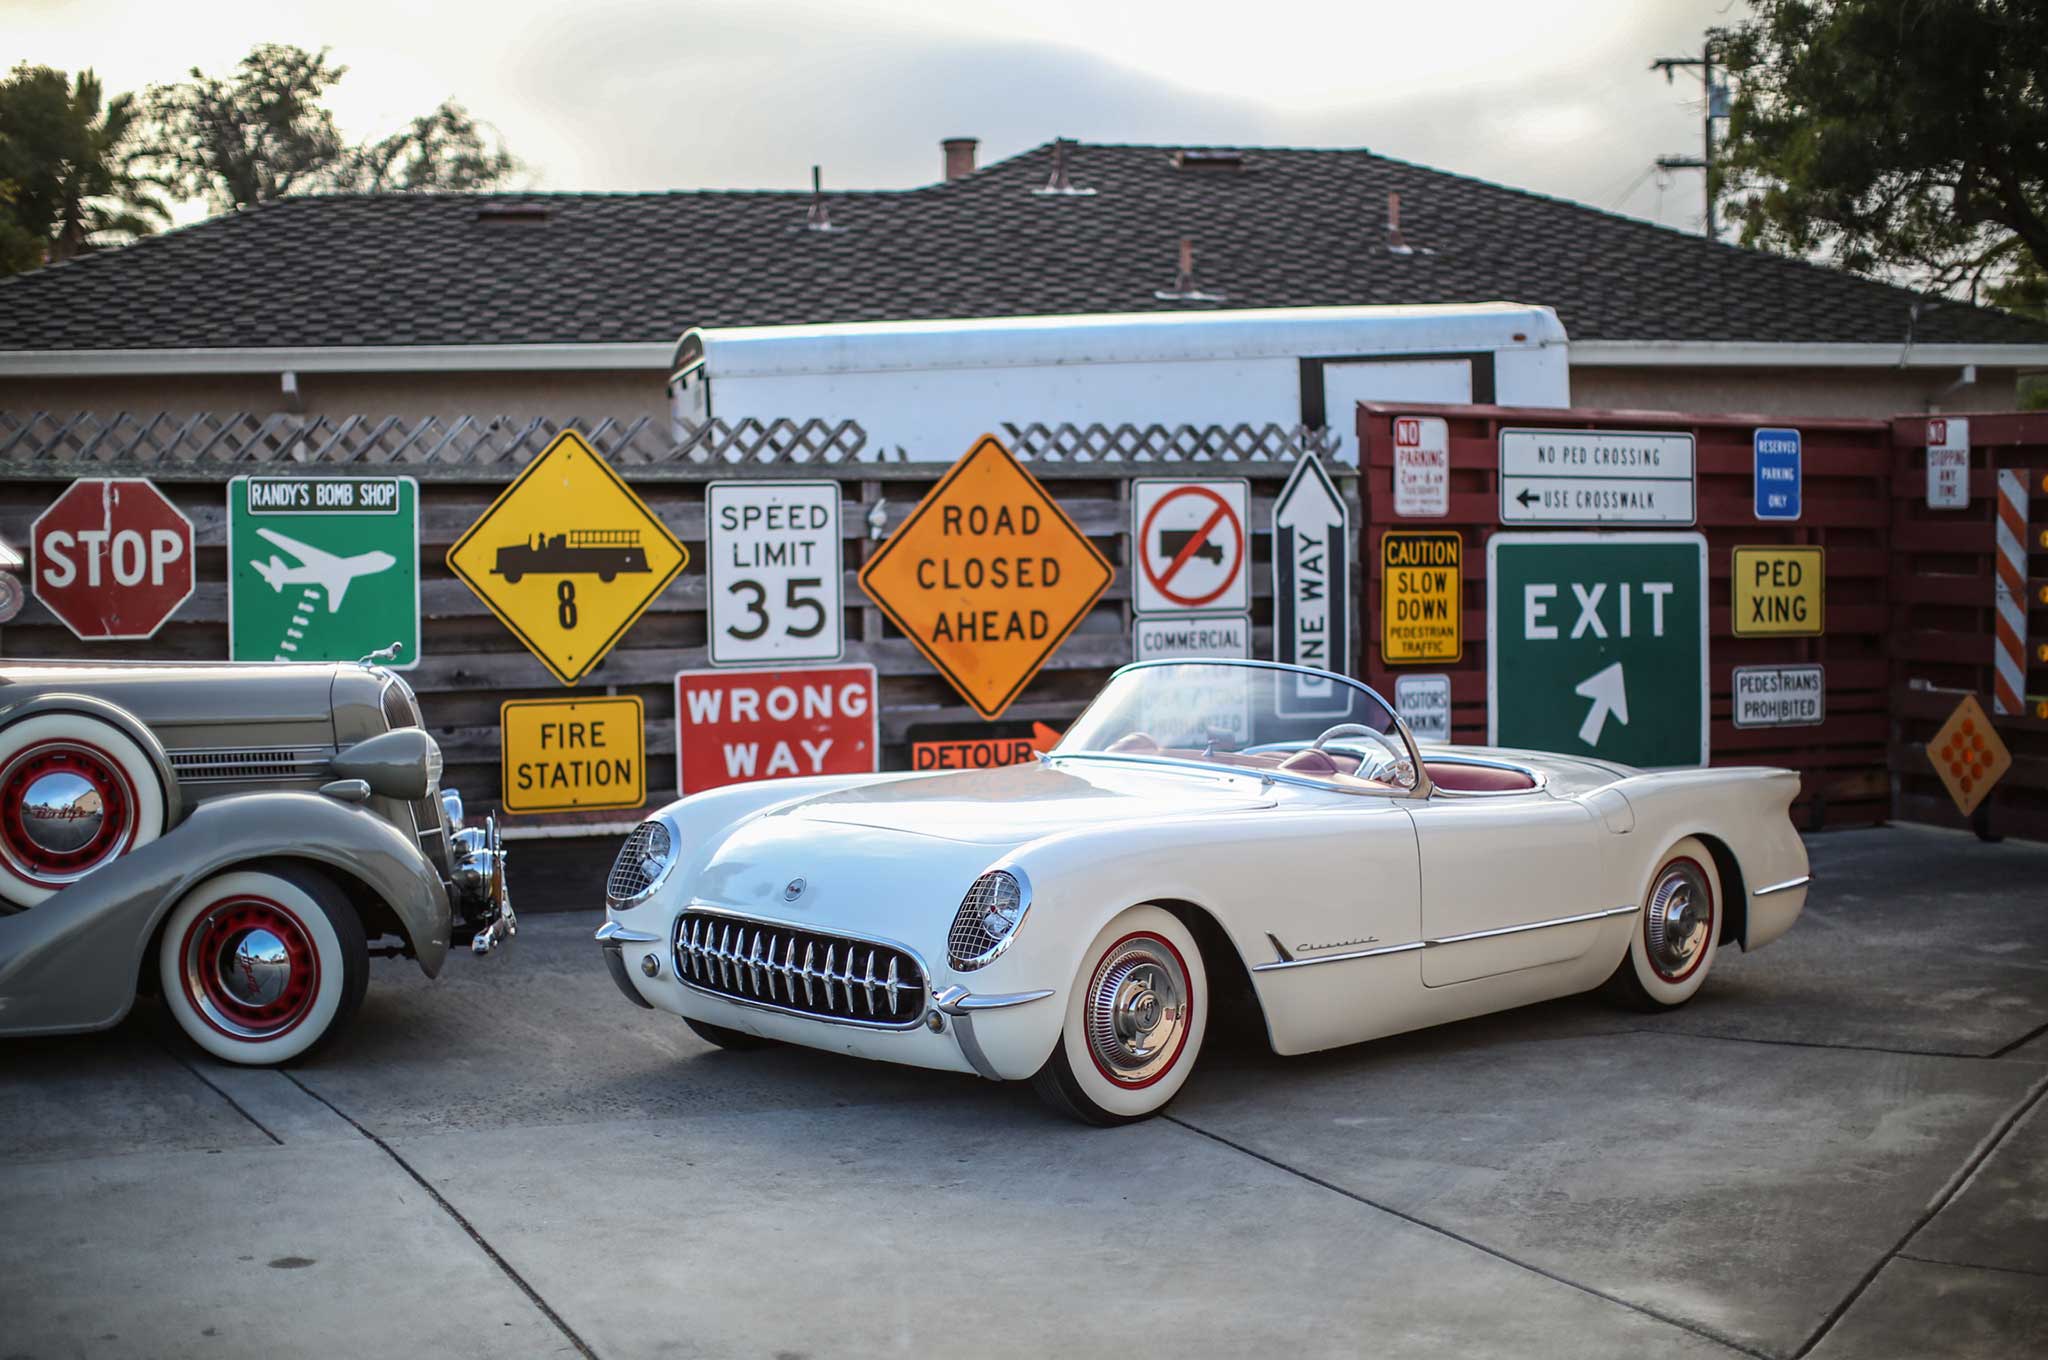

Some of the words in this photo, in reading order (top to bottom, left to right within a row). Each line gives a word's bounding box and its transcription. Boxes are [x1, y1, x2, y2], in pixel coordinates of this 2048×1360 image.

[1398, 421, 1418, 445] NO
[1400, 450, 1443, 467] PARKING
[1538, 446, 1555, 464] NO
[1563, 447, 1587, 465] PED
[1594, 448, 1660, 467] CROSSING
[1759, 440, 1797, 454] RESERVED
[1762, 467, 1794, 481] PARKING
[252, 486, 310, 507] RANDY'S
[317, 487, 353, 506] BOMB
[359, 486, 396, 506] SHOP
[1544, 491, 1568, 508] USE
[1576, 490, 1655, 509] CROSSWALK
[1769, 494, 1788, 508] ONLY
[720, 506, 829, 532] SPEED
[943, 505, 1041, 537] ROAD
[42, 529, 184, 588] STOP
[733, 542, 816, 569] LIMIT
[1387, 541, 1457, 565] CAUTION
[916, 558, 1061, 590] CLOSED
[1299, 532, 1323, 602] WAY
[1755, 560, 1801, 588] PED
[1398, 572, 1447, 593] SLOW
[556, 580, 578, 631] 8
[726, 578, 827, 641] 35
[1397, 599, 1447, 621] DOWN
[1523, 582, 1675, 641] EXIT
[1752, 596, 1807, 624] XING
[932, 610, 1049, 643] AHEAD
[1390, 626, 1454, 638] PEDESTRIAN
[1143, 629, 1242, 651] COMMERCIAL
[1300, 617, 1325, 687] ONE
[1401, 641, 1442, 653] TRAFFIC
[1739, 673, 1819, 693] PEDESTRIANS
[686, 683, 868, 725] WRONG
[1744, 699, 1816, 718] PROHIBITED
[540, 722, 607, 750] FIRE
[723, 740, 834, 778] WAY
[918, 743, 1032, 769] DETOUR
[517, 759, 632, 790] STATION
